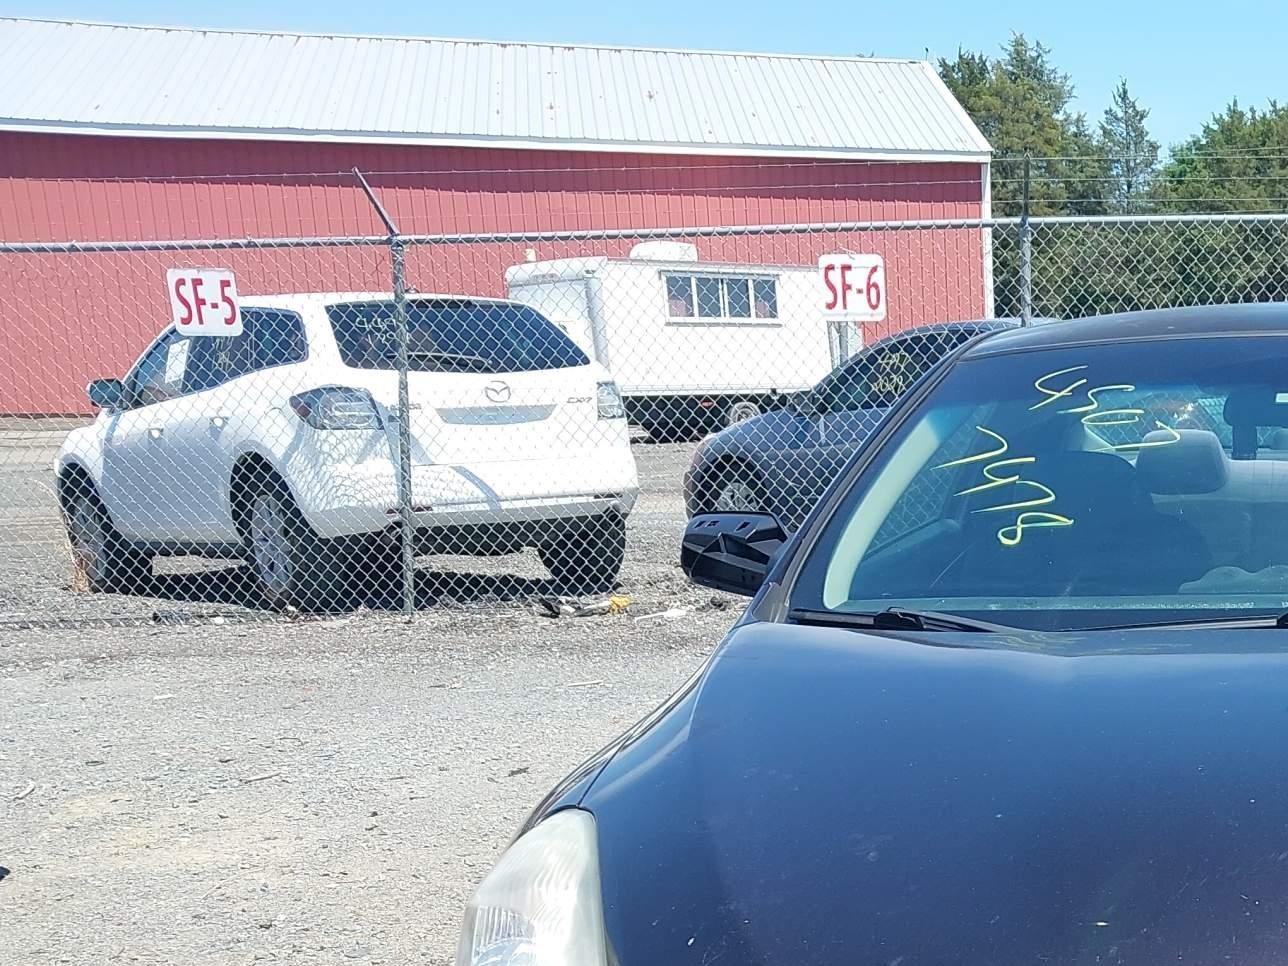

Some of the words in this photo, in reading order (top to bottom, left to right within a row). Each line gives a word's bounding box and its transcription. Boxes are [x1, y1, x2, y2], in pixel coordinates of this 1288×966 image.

[174, 277, 237, 325] SF-5
[823, 263, 880, 310] SF-6
[1028, 365, 1181, 452] 4507
[930, 425, 1074, 545] 7478
